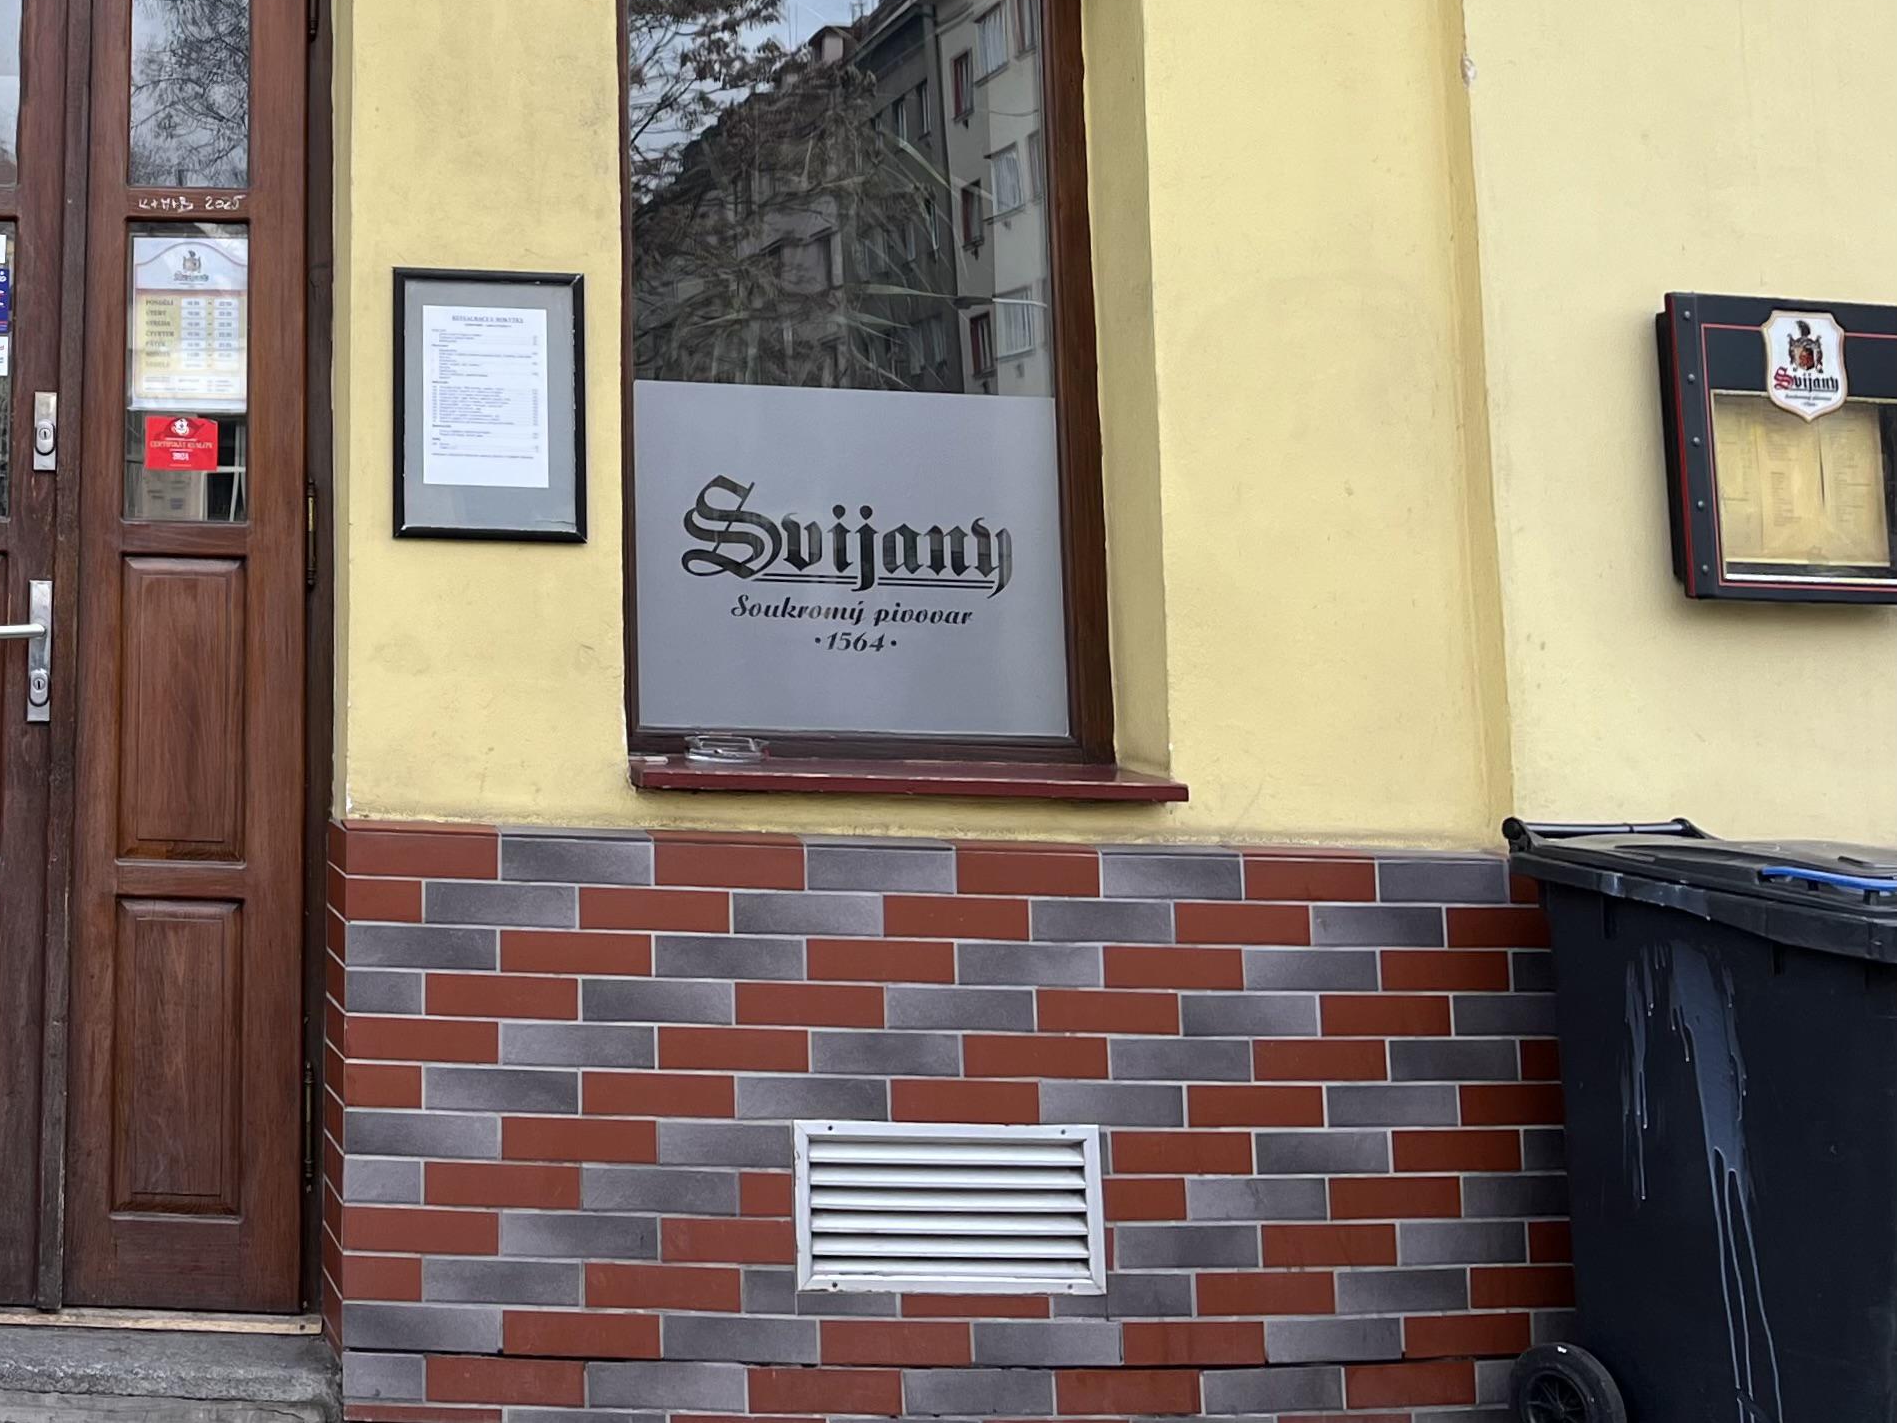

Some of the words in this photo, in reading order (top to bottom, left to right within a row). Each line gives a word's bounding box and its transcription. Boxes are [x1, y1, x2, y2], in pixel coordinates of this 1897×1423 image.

[1774, 366, 1839, 393] Svijany
[681, 474, 1013, 599] Svijany
[731, 594, 864, 626] Soukromý
[873, 602, 974, 627] pivovar
